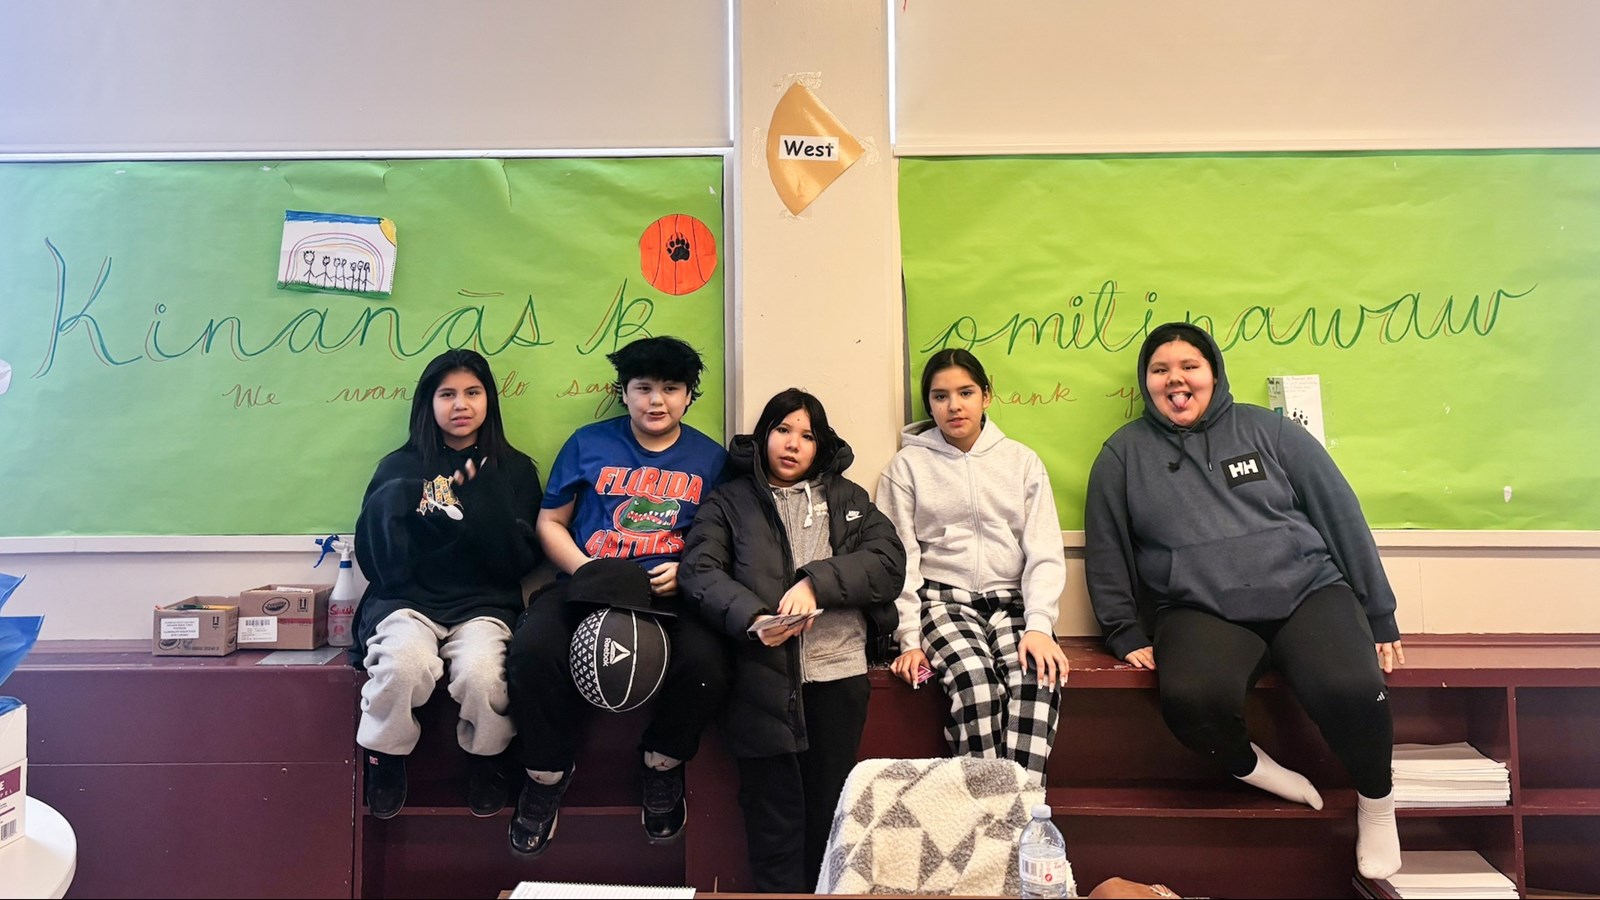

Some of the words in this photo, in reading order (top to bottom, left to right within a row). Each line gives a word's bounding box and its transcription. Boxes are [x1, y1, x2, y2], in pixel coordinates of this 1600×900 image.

[783, 139, 834, 157] West
[221, 383, 281, 409] We
[326, 380, 420, 404] wan
[556, 379, 617, 420] say
[988, 374, 1078, 406] hank
[1228, 458, 1259, 478] HH
[595, 466, 704, 505] FLORIDA
[602, 637, 612, 667] Reebok
